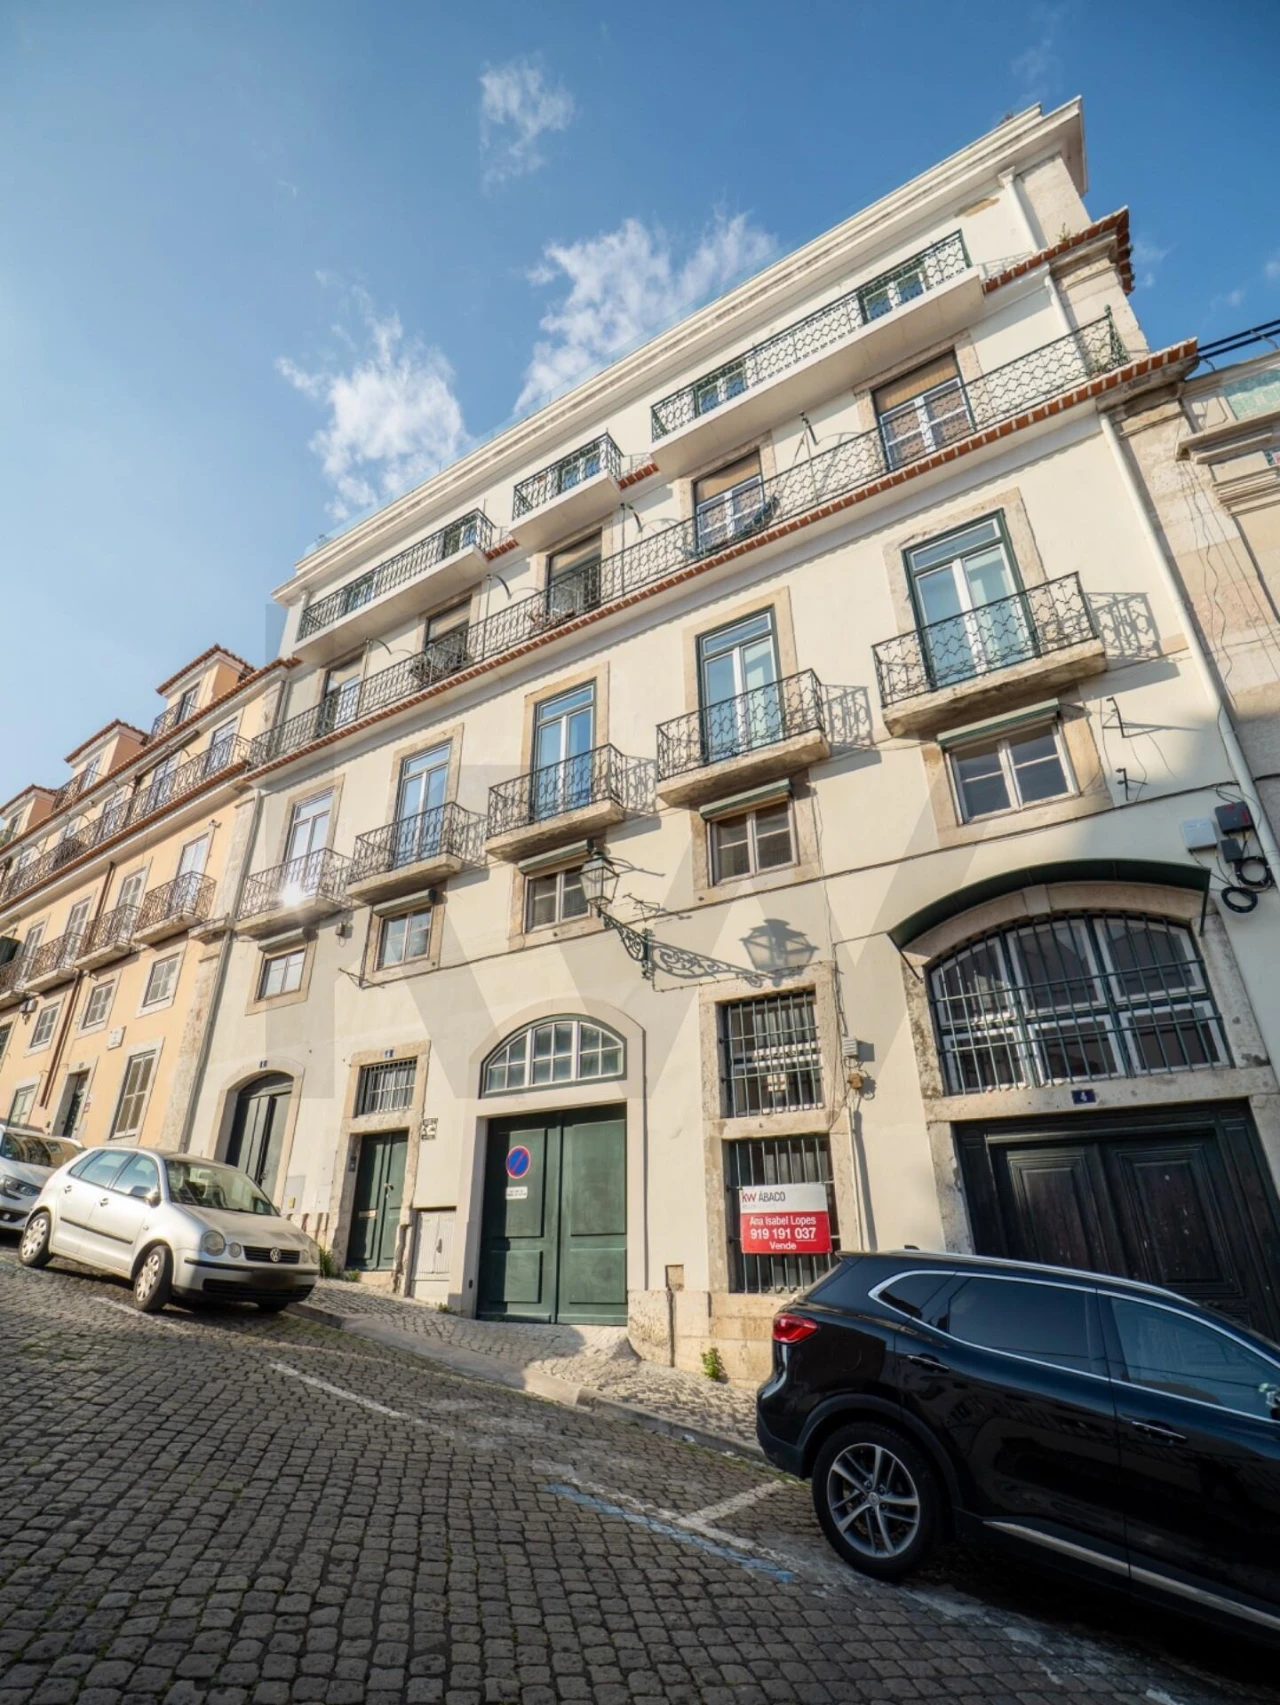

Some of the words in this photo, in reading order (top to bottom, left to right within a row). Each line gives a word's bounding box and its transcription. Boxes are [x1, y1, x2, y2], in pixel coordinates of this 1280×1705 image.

[758, 1190, 786, 1202] ÁBACO
[750, 1216, 764, 1226] Ana
[765, 1215, 788, 1225] Isabel
[790, 1215, 816, 1226] Lopes
[750, 1228, 769, 1239] 919
[773, 1228, 791, 1239] 191
[795, 1227, 816, 1239] 037
[769, 1241, 797, 1250] Vende
